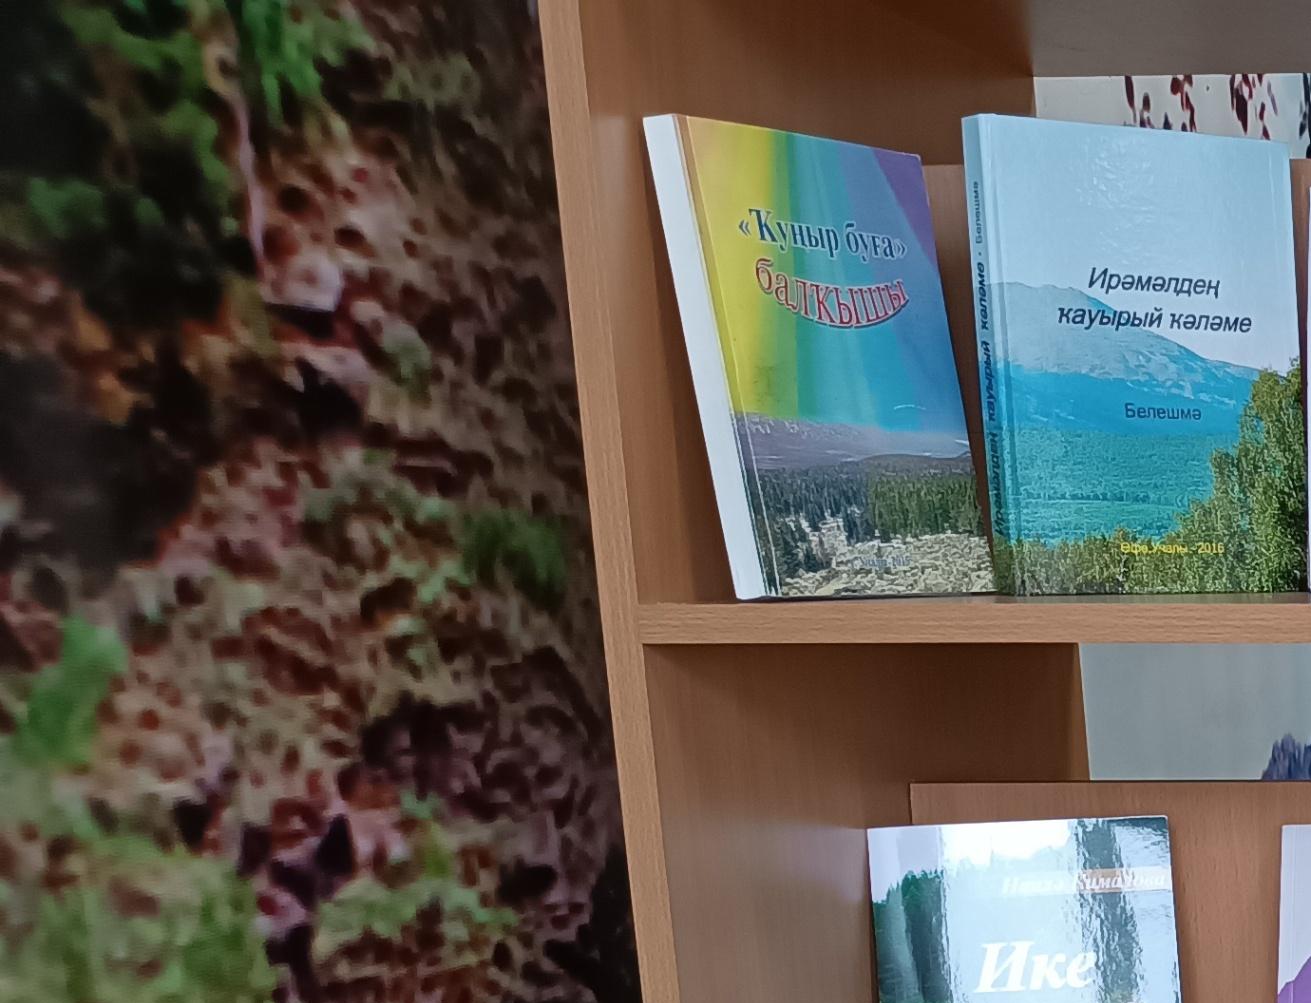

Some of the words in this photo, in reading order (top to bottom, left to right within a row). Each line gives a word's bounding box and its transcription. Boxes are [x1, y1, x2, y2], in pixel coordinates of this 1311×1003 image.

[1088, 267, 1221, 298] Ирәмәлдең
[1124, 402, 1202, 421] Белешмә
[1198, 541, 1225, 554] 2016
[973, 939, 1097, 995] Ике
